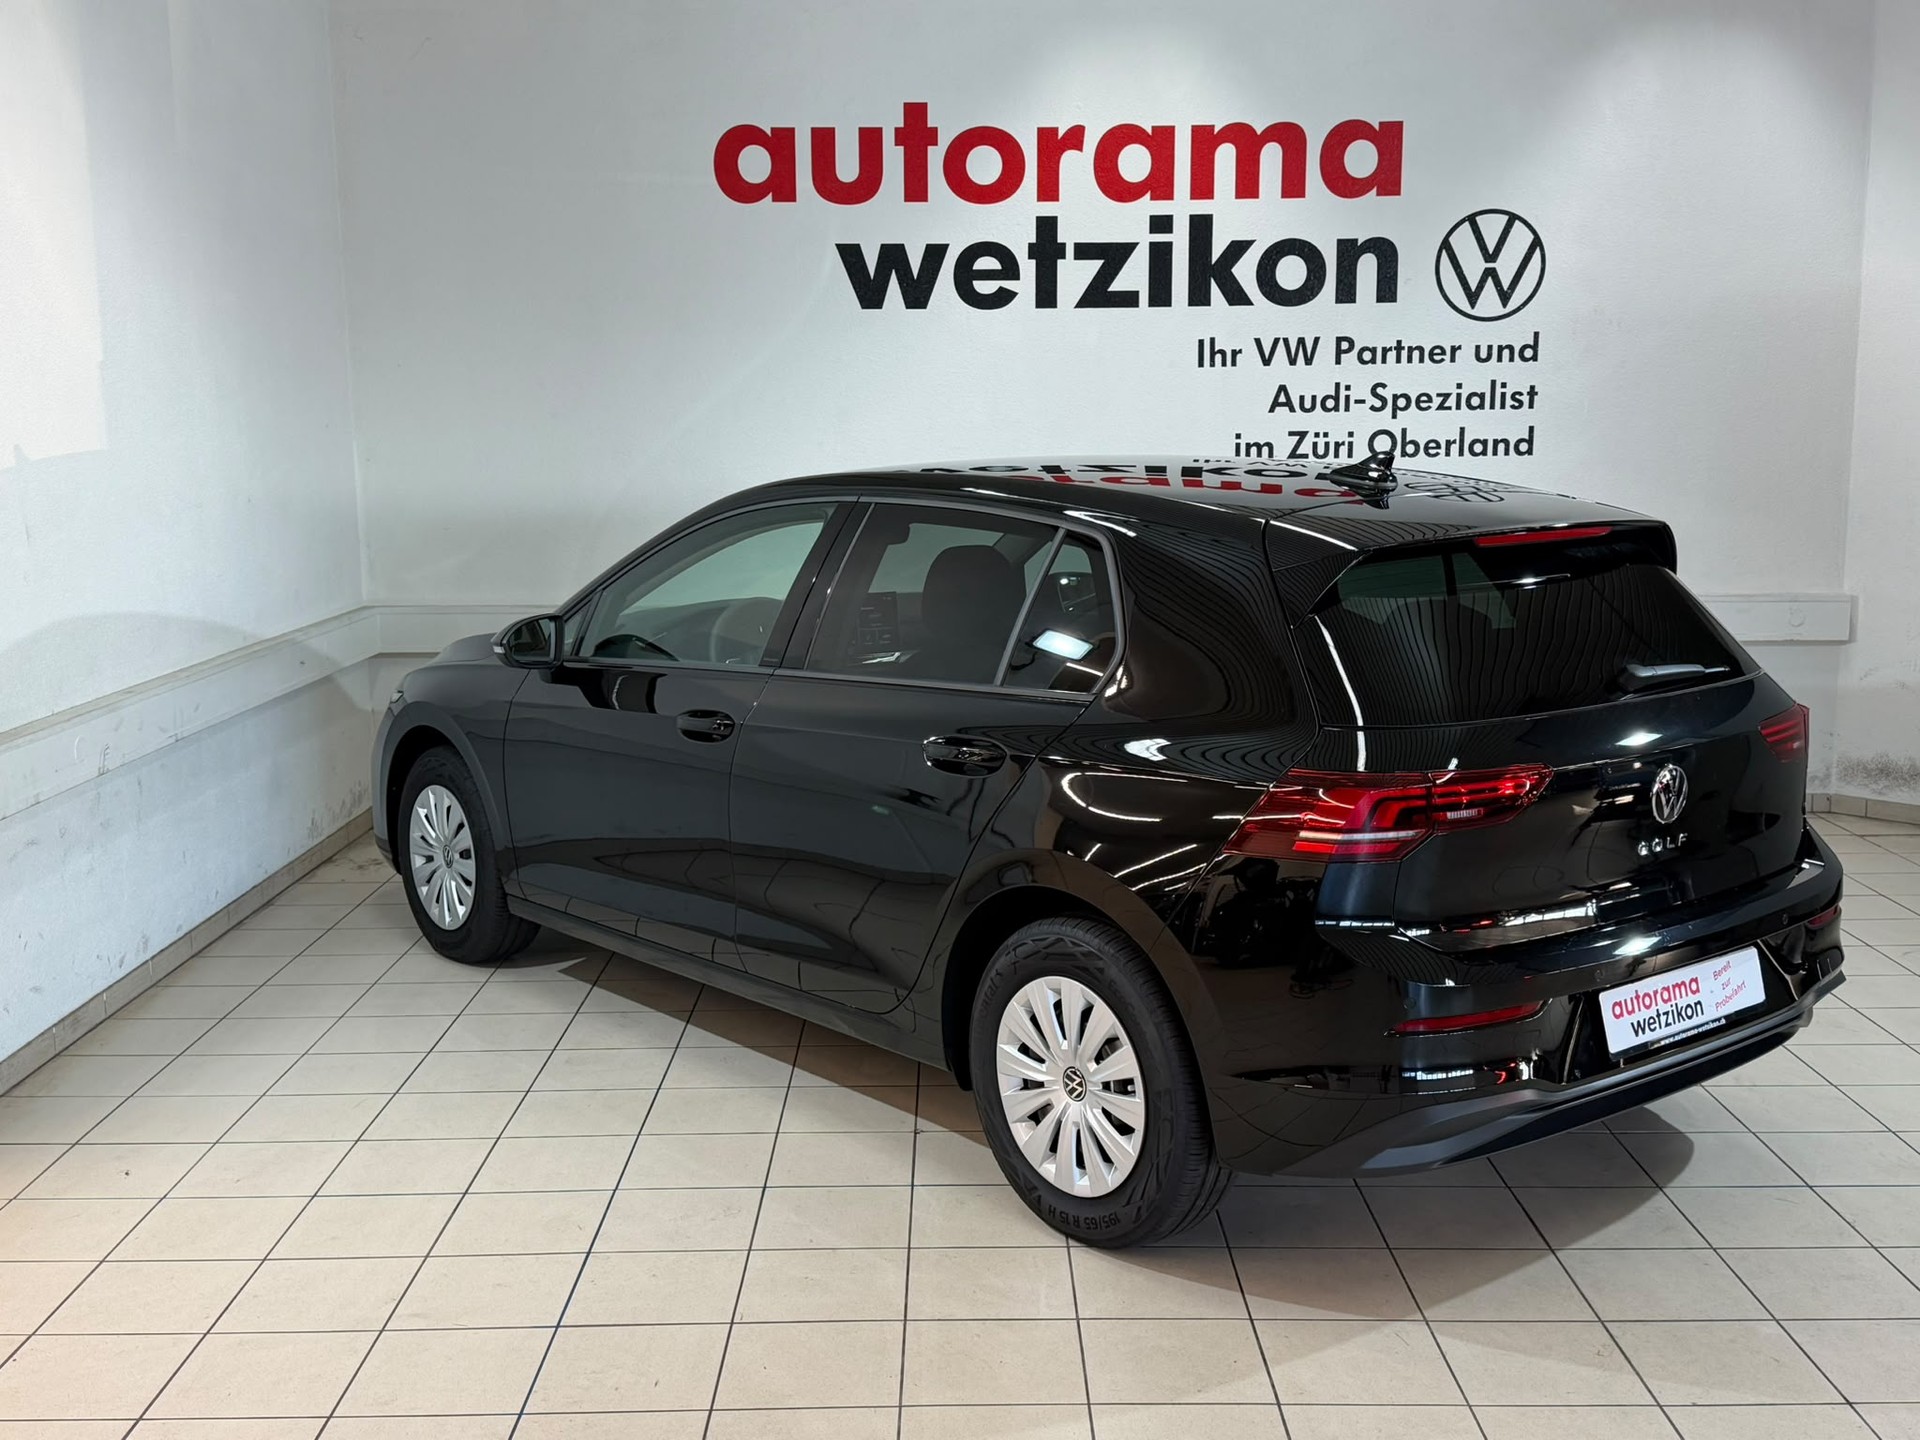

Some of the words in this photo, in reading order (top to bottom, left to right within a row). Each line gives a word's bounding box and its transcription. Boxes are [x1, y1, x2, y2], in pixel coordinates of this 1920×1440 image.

[714, 102, 1404, 206] autorama
[834, 213, 1399, 311] wetzikon
[1197, 337, 1243, 368] Ihr
[1253, 336, 1321, 367] VW
[1334, 335, 1463, 366] Partner
[1474, 331, 1540, 364] und
[1268, 379, 1539, 419] Audi-Spezialist
[1234, 432, 1275, 459] im
[1286, 430, 1355, 460] Züri
[1367, 426, 1535, 458] Oberland
[1637, 833, 1688, 856] GOLF
[1712, 960, 1732, 982] Bereit
[1720, 976, 1732, 991] zur
[1611, 976, 1701, 1020] autorama
[1715, 979, 1747, 1012] Probefahrt
[1630, 999, 1705, 1038] wetzikon
